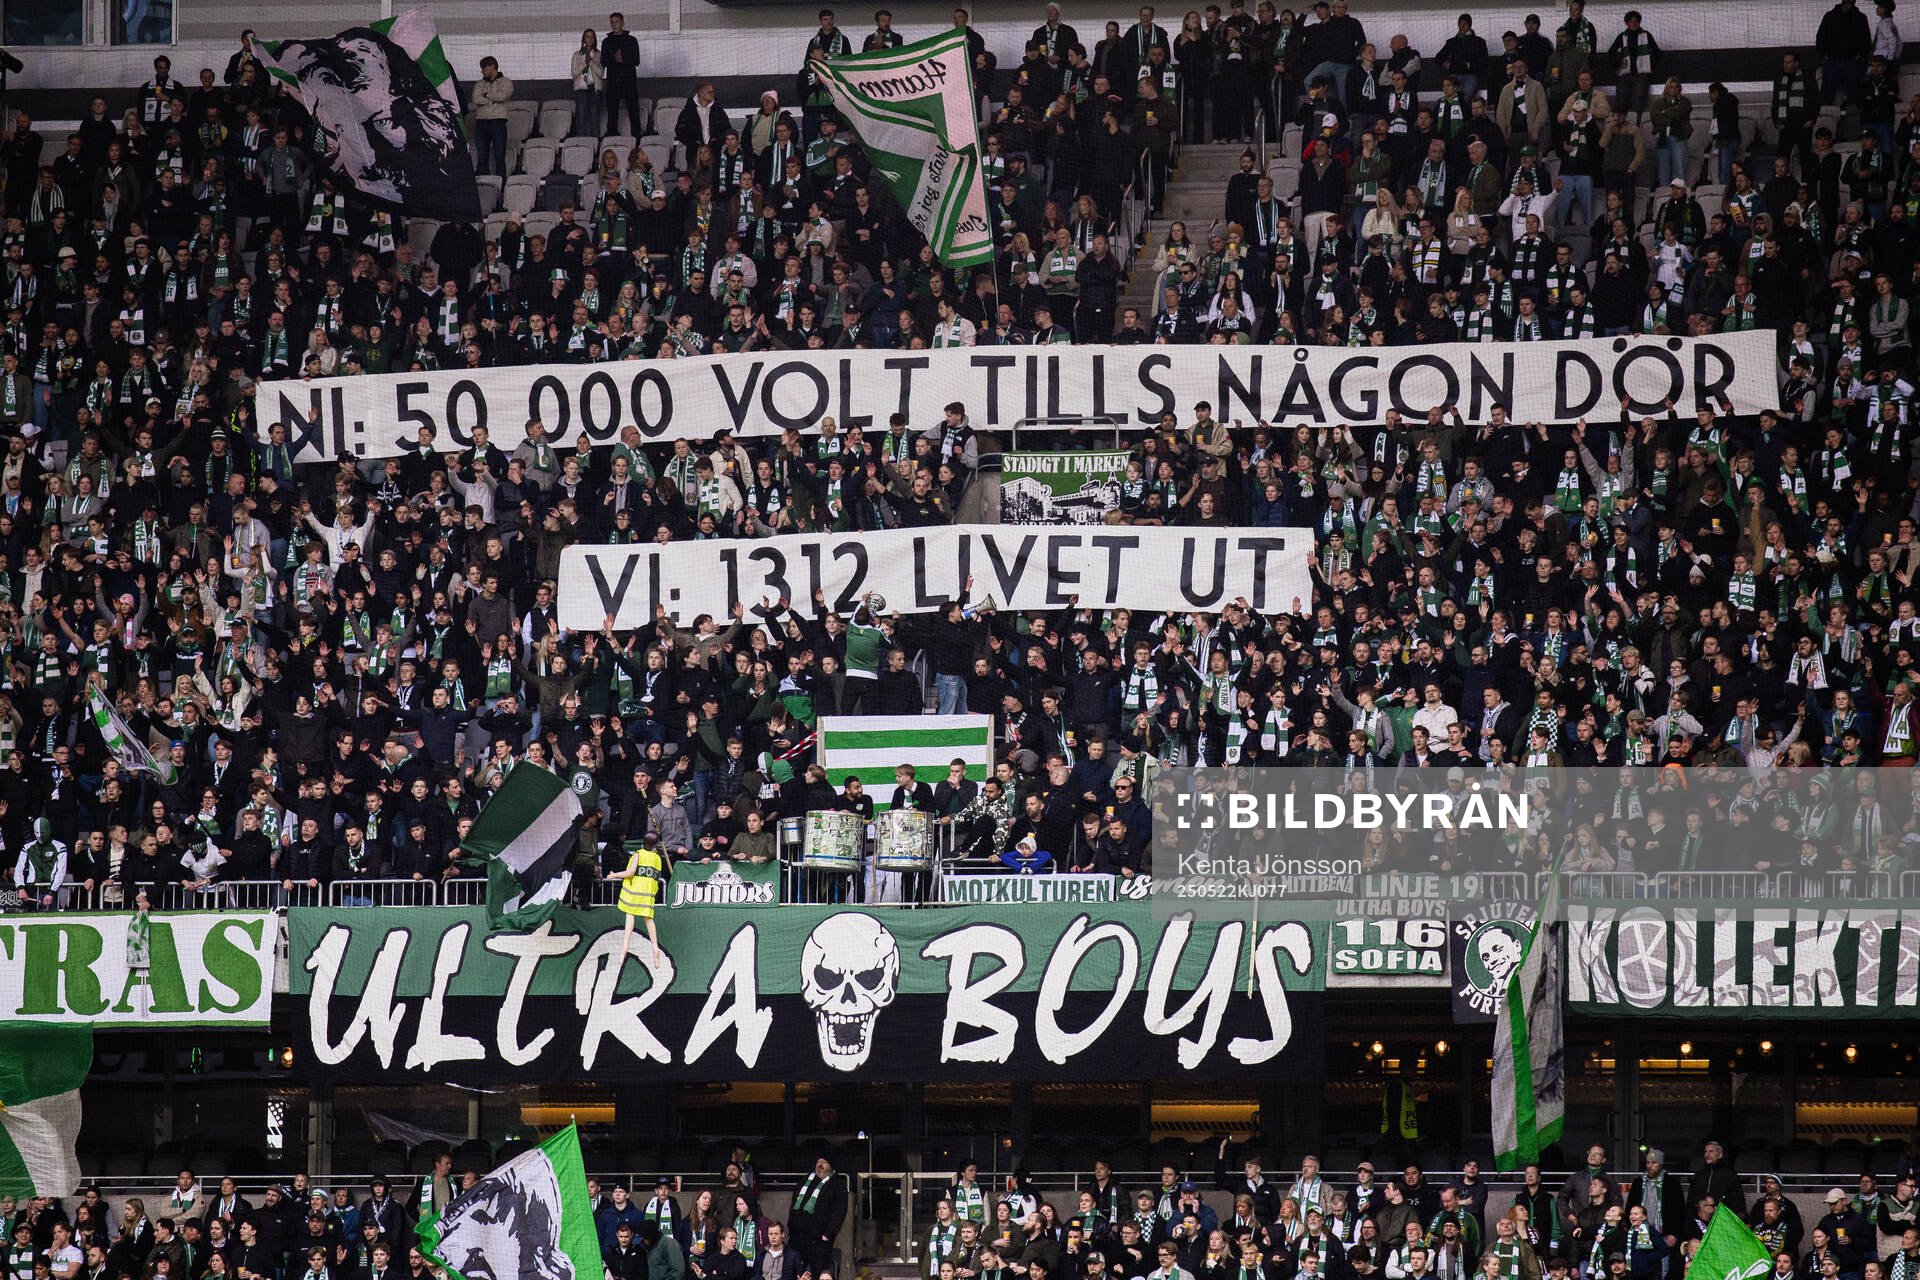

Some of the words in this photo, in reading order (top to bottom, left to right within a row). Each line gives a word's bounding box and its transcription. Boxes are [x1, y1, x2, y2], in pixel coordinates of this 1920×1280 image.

[279, 387, 364, 458] NI:
[396, 379, 488, 453] 50
[530, 369, 673, 443] 000
[711, 356, 929, 434] VOLT
[971, 353, 1176, 425] TILLS
[1218, 347, 1513, 424] NÅGON
[1555, 337, 1736, 420] DÖR
[1003, 456, 1060, 474] STADIGT
[1063, 456, 1070, 473] I
[1073, 454, 1130, 473] MARKEN
[585, 553, 681, 622] VI:
[720, 541, 869, 619] 1312
[914, 534, 1139, 606] LIVET
[1180, 537, 1286, 609] UT
[671, 881, 775, 908] JUNIORS
[948, 878, 1110, 902] MOTKULTUREN
[1365, 875, 1440, 898] LINJE
[1450, 875, 1479, 898] 19
[1336, 899, 1393, 916] ULTRA
[1396, 899, 1447, 917] BOYS
[1336, 918, 1447, 948] 116
[0, 919, 264, 1014] RAS
[1335, 949, 1443, 970] SOFIA
[305, 919, 773, 1072] ULTRA
[921, 912, 1313, 1070] BOYS
